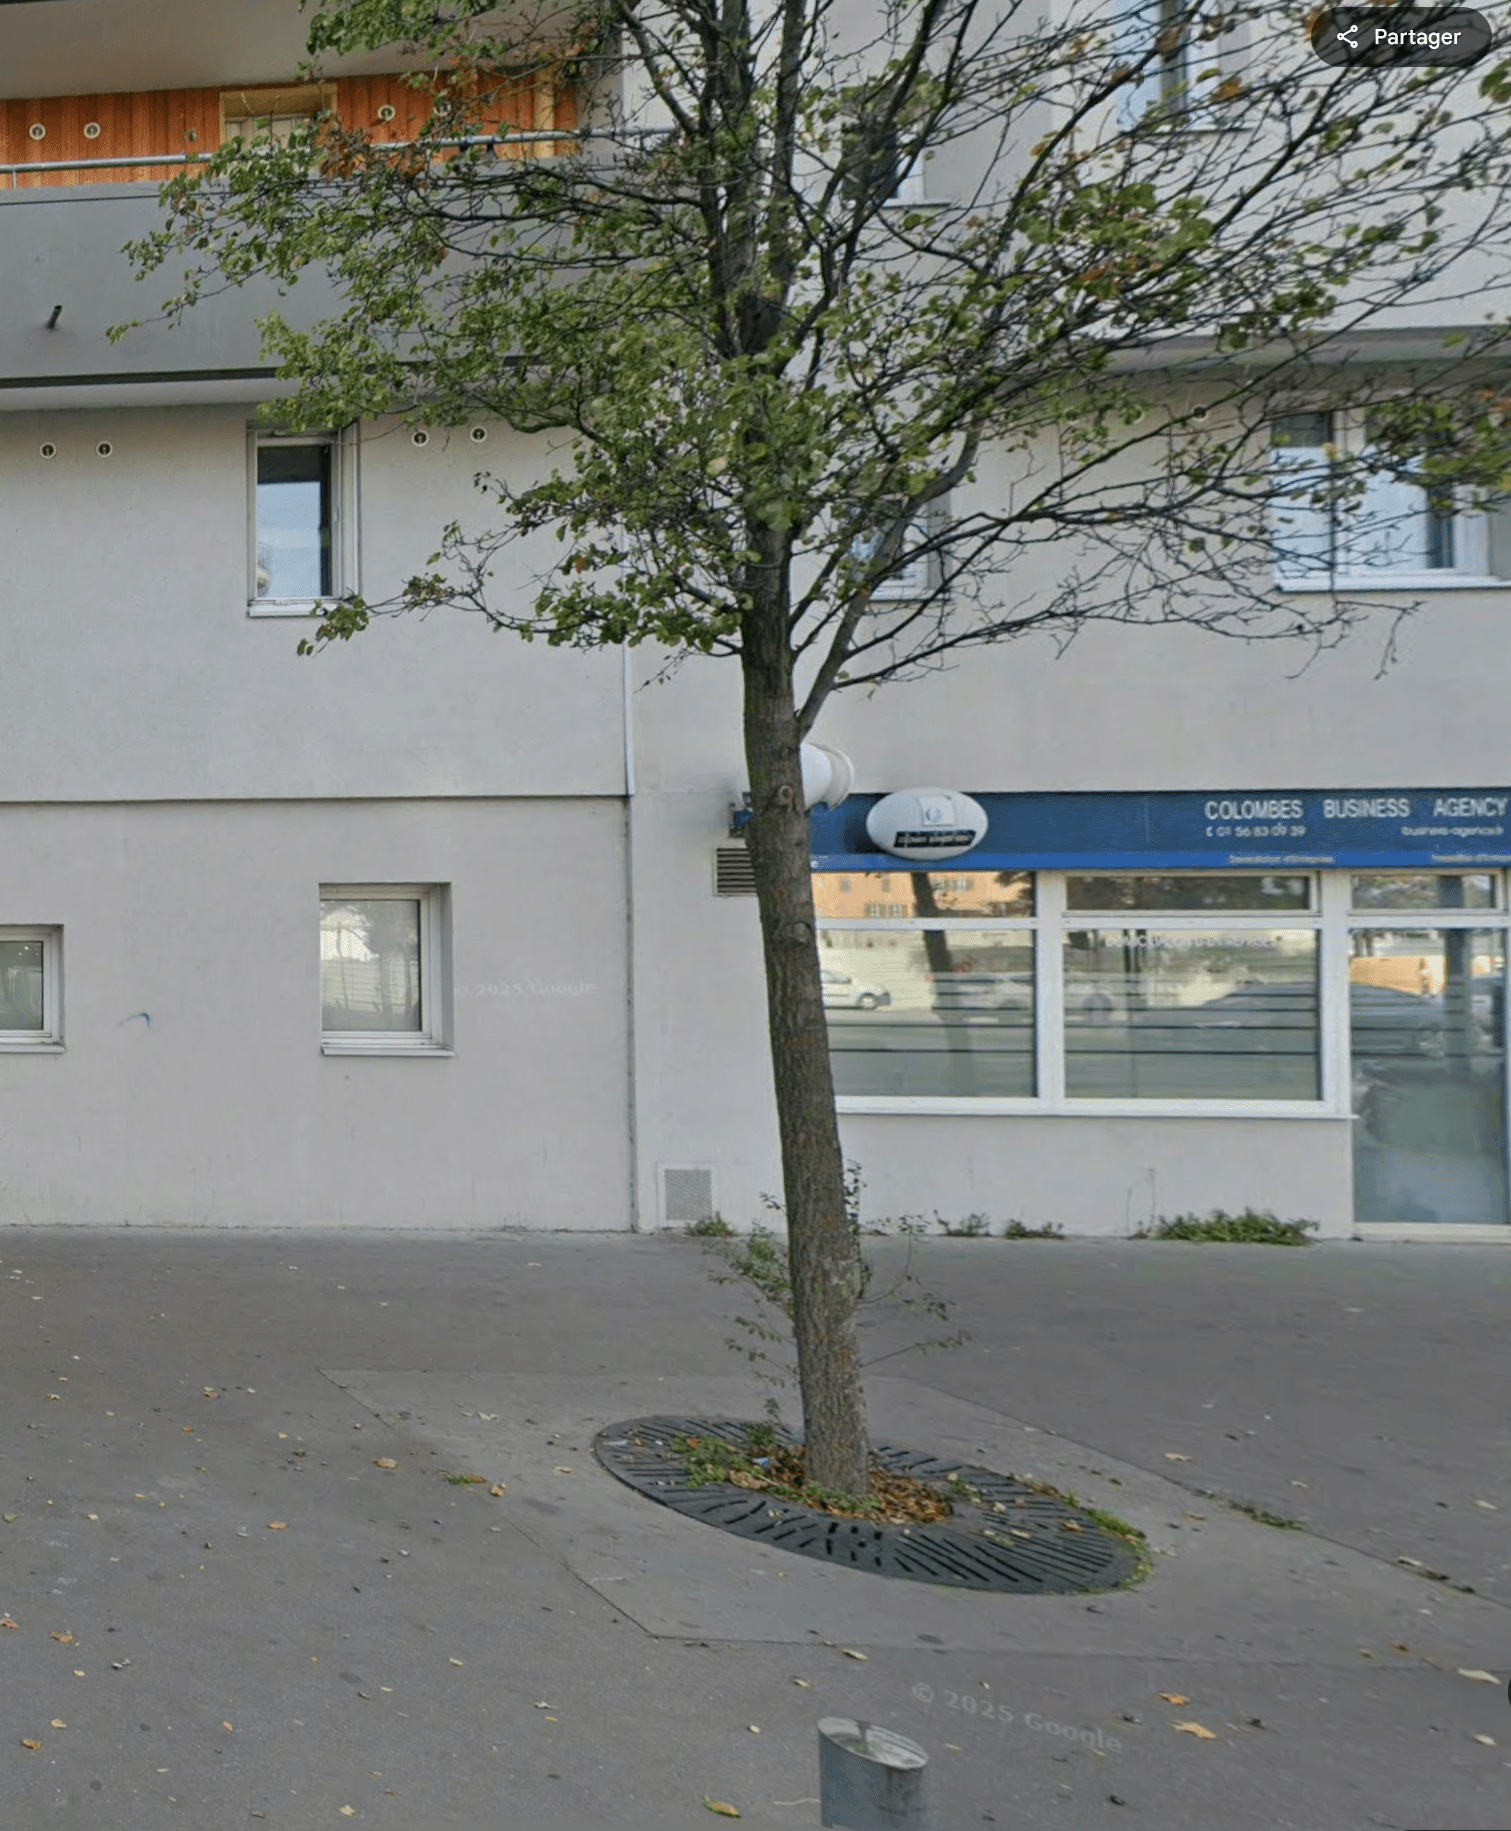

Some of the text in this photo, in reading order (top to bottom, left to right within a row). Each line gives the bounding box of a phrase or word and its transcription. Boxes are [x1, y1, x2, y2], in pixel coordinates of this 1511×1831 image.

[1204, 797, 1508, 820] COLOMBES BUSINESS AGENCY
[1235, 826, 1251, 837] 56
[1253, 826, 1270, 837] 83
